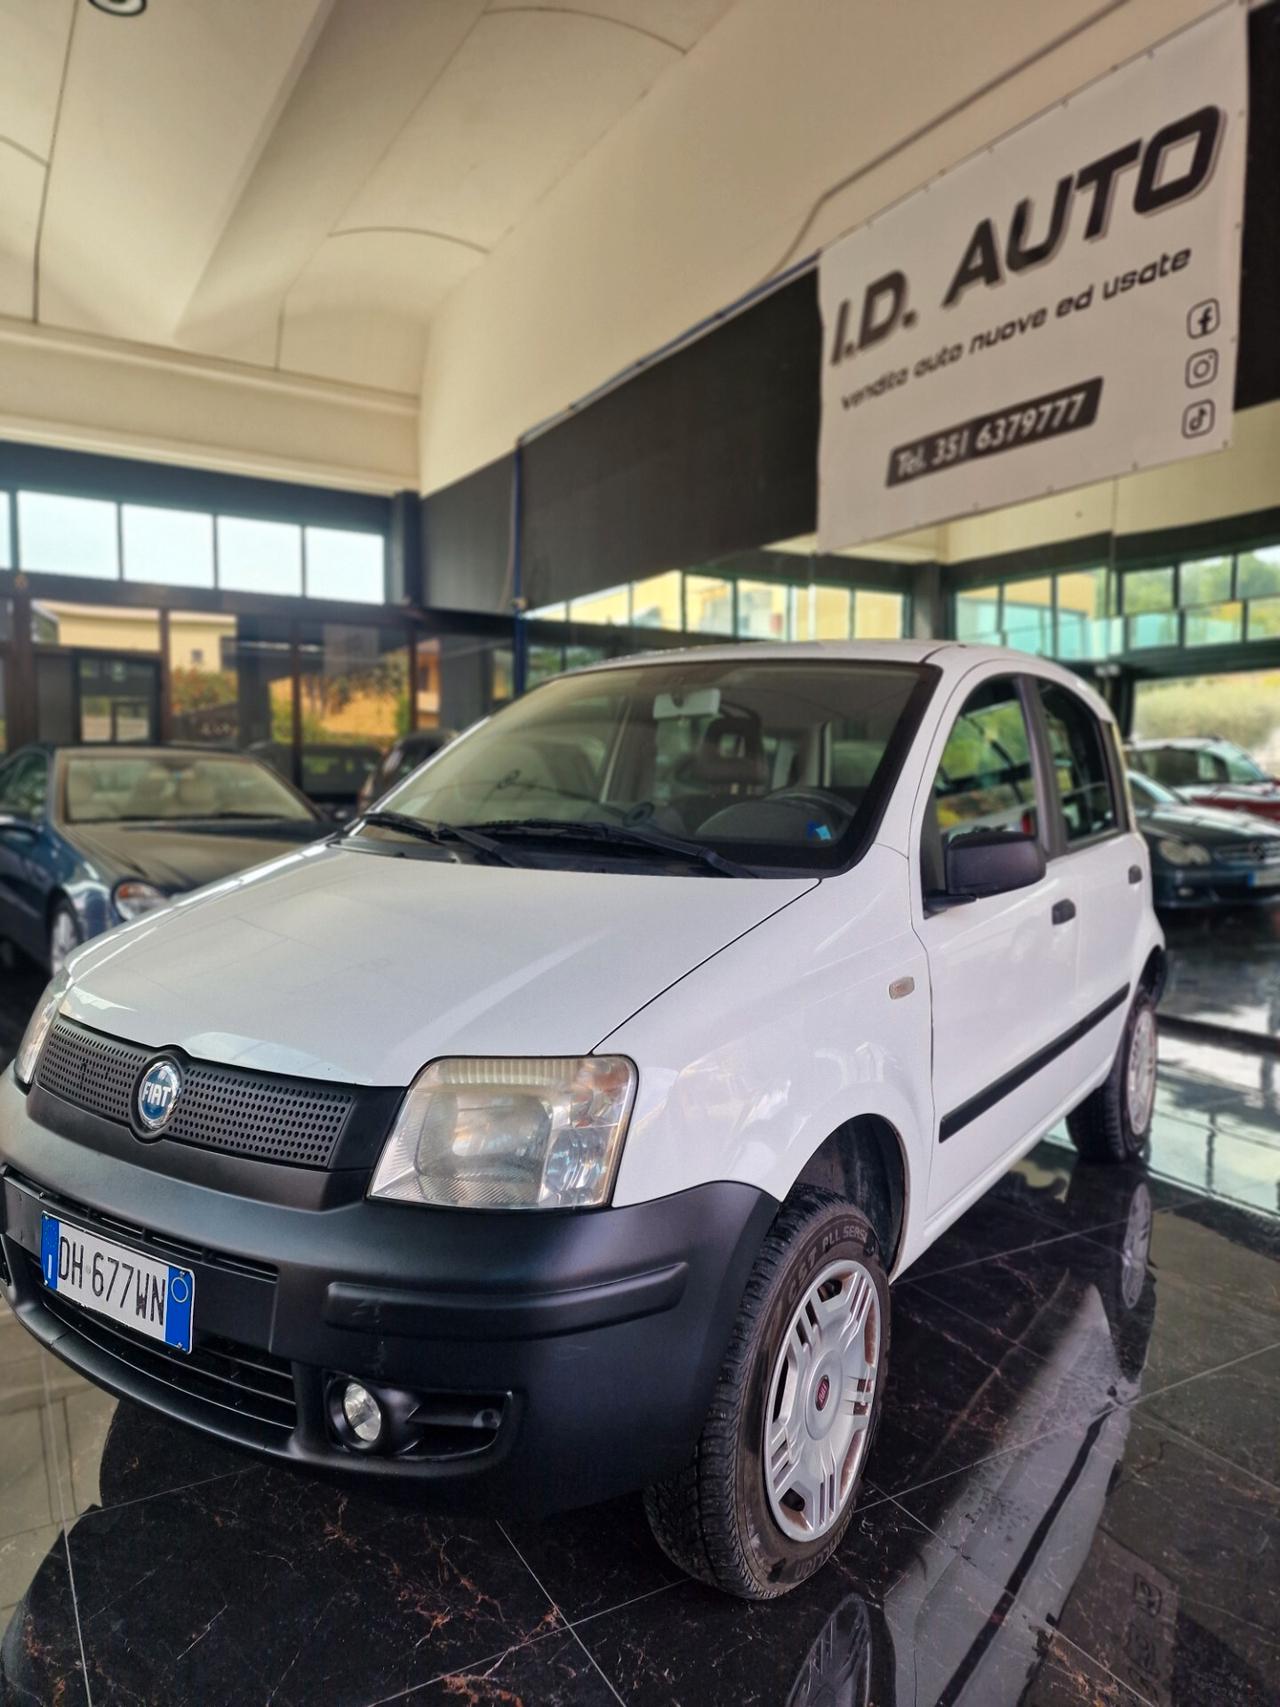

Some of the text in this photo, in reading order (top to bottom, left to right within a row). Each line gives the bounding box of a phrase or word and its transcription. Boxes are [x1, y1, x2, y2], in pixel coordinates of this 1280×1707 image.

[830, 105, 1224, 366] I.D. AUTO
[914, 343, 963, 378] auto
[969, 309, 1047, 354] nuove
[1056, 284, 1093, 318] ed
[1103, 248, 1192, 300] usate
[932, 430, 970, 466] 351
[975, 392, 1087, 451] 6379777
[142, 1081, 171, 1107] FIAT
[58, 1235, 84, 1289] DH
[92, 1251, 166, 1326] 677WN
